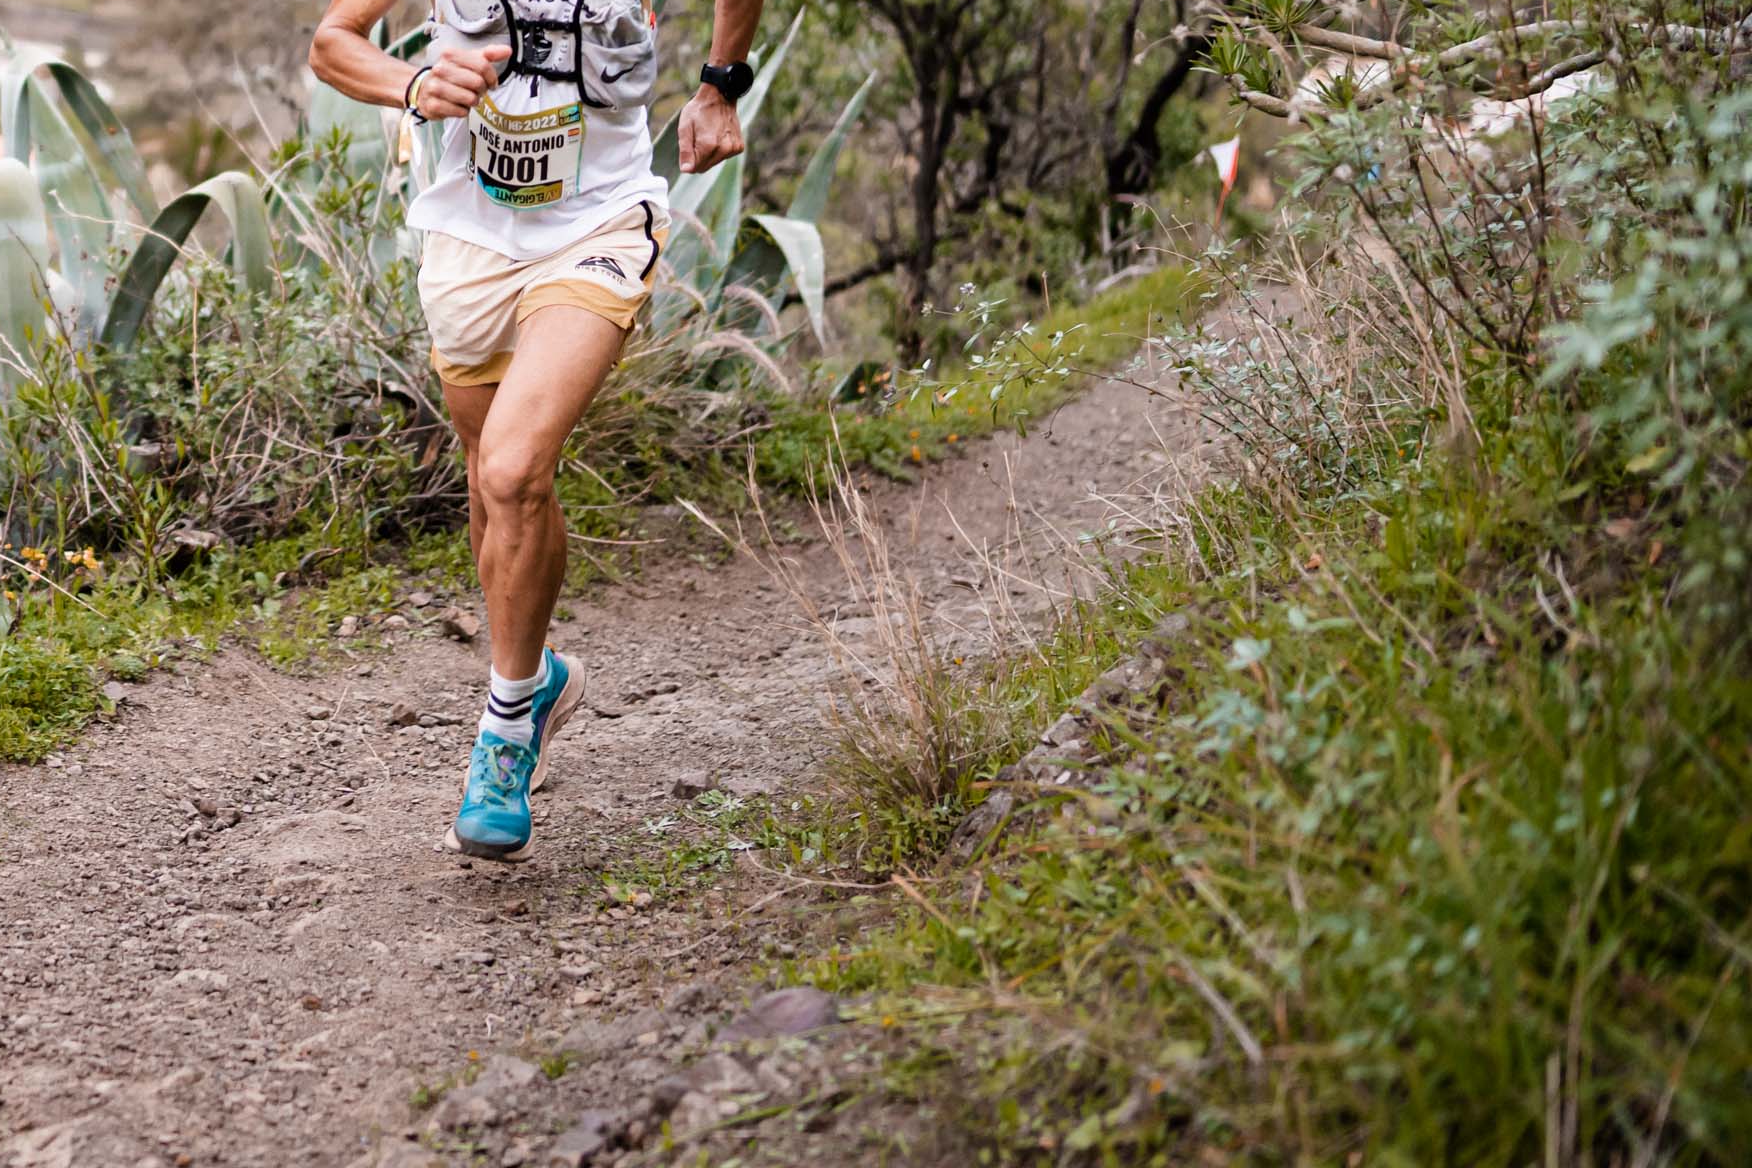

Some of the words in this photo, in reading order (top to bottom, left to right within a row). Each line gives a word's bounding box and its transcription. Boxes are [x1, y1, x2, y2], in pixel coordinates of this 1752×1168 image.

[479, 123, 500, 149] JOSÉ
[503, 134, 564, 153] ANTONIO
[487, 146, 549, 183] 7001
